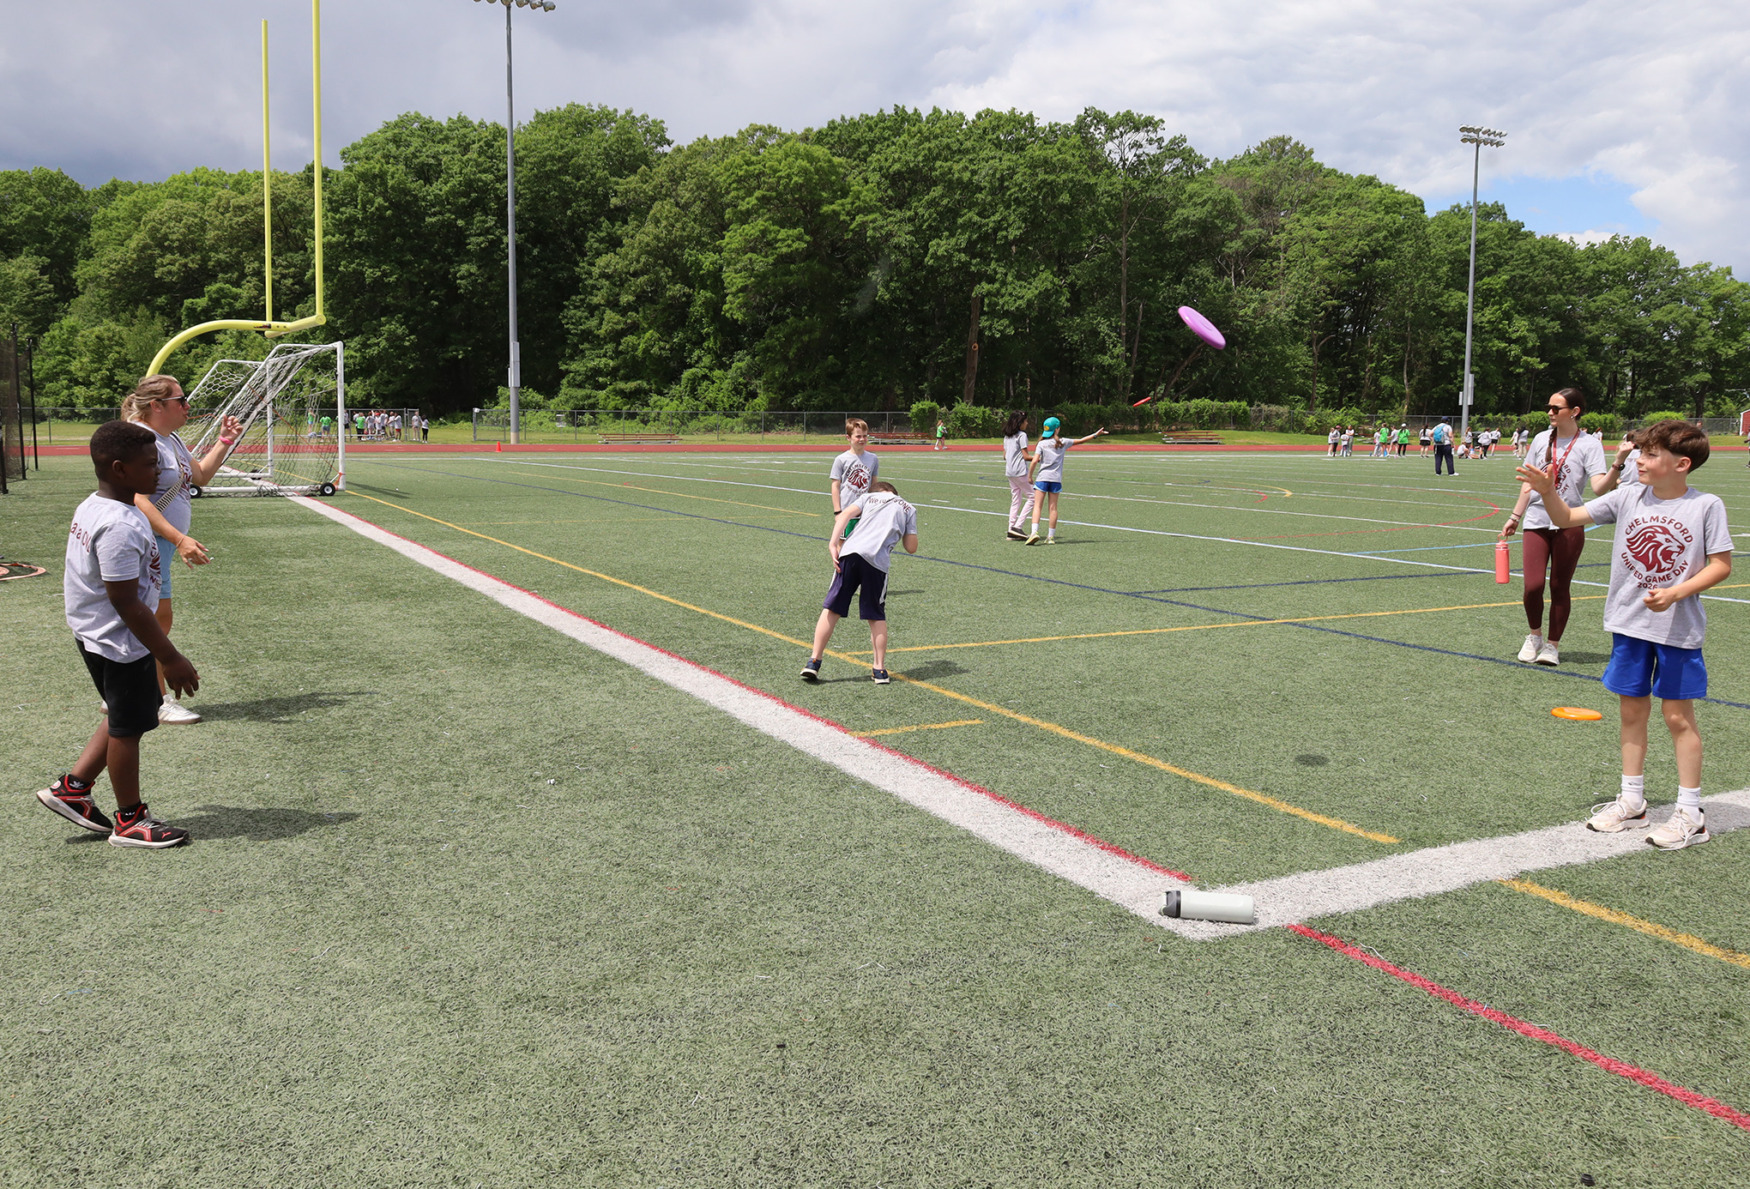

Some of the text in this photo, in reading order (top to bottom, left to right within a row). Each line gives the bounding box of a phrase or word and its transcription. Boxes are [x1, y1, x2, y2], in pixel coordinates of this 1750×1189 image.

[1625, 515, 1693, 543] CHELMSFORD
[1621, 552, 1688, 583] UNIFED GAME DAY
